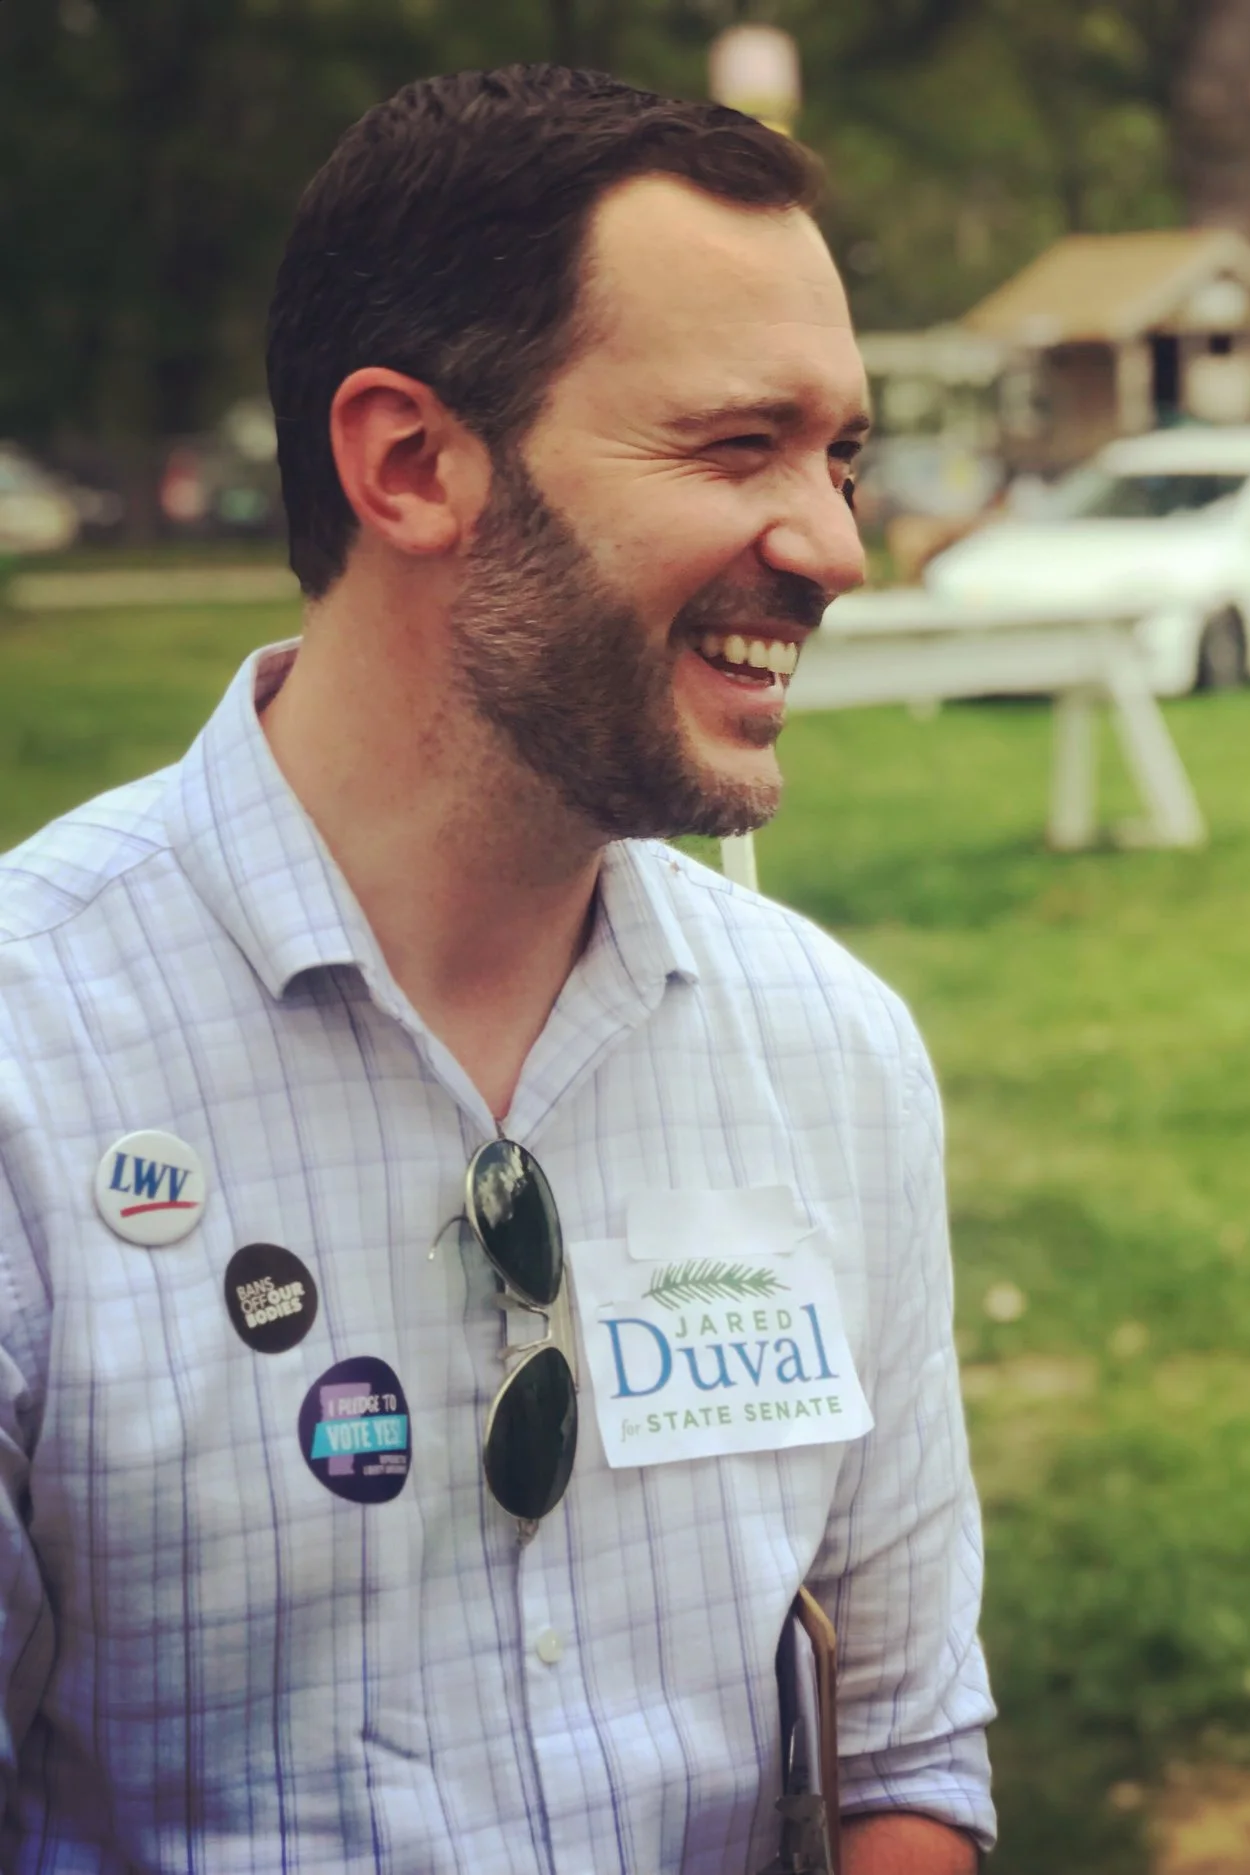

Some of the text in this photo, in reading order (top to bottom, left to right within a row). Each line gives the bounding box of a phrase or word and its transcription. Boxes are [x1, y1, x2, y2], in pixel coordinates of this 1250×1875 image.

[108, 1152, 192, 1203] LWV
[674, 1309, 793, 1339] JARED
[598, 1302, 840, 1400] Duval
[382, 1394, 397, 1412] TO
[620, 1396, 843, 1443] for STATE SENATE
[325, 1420, 372, 1452] VOTE
